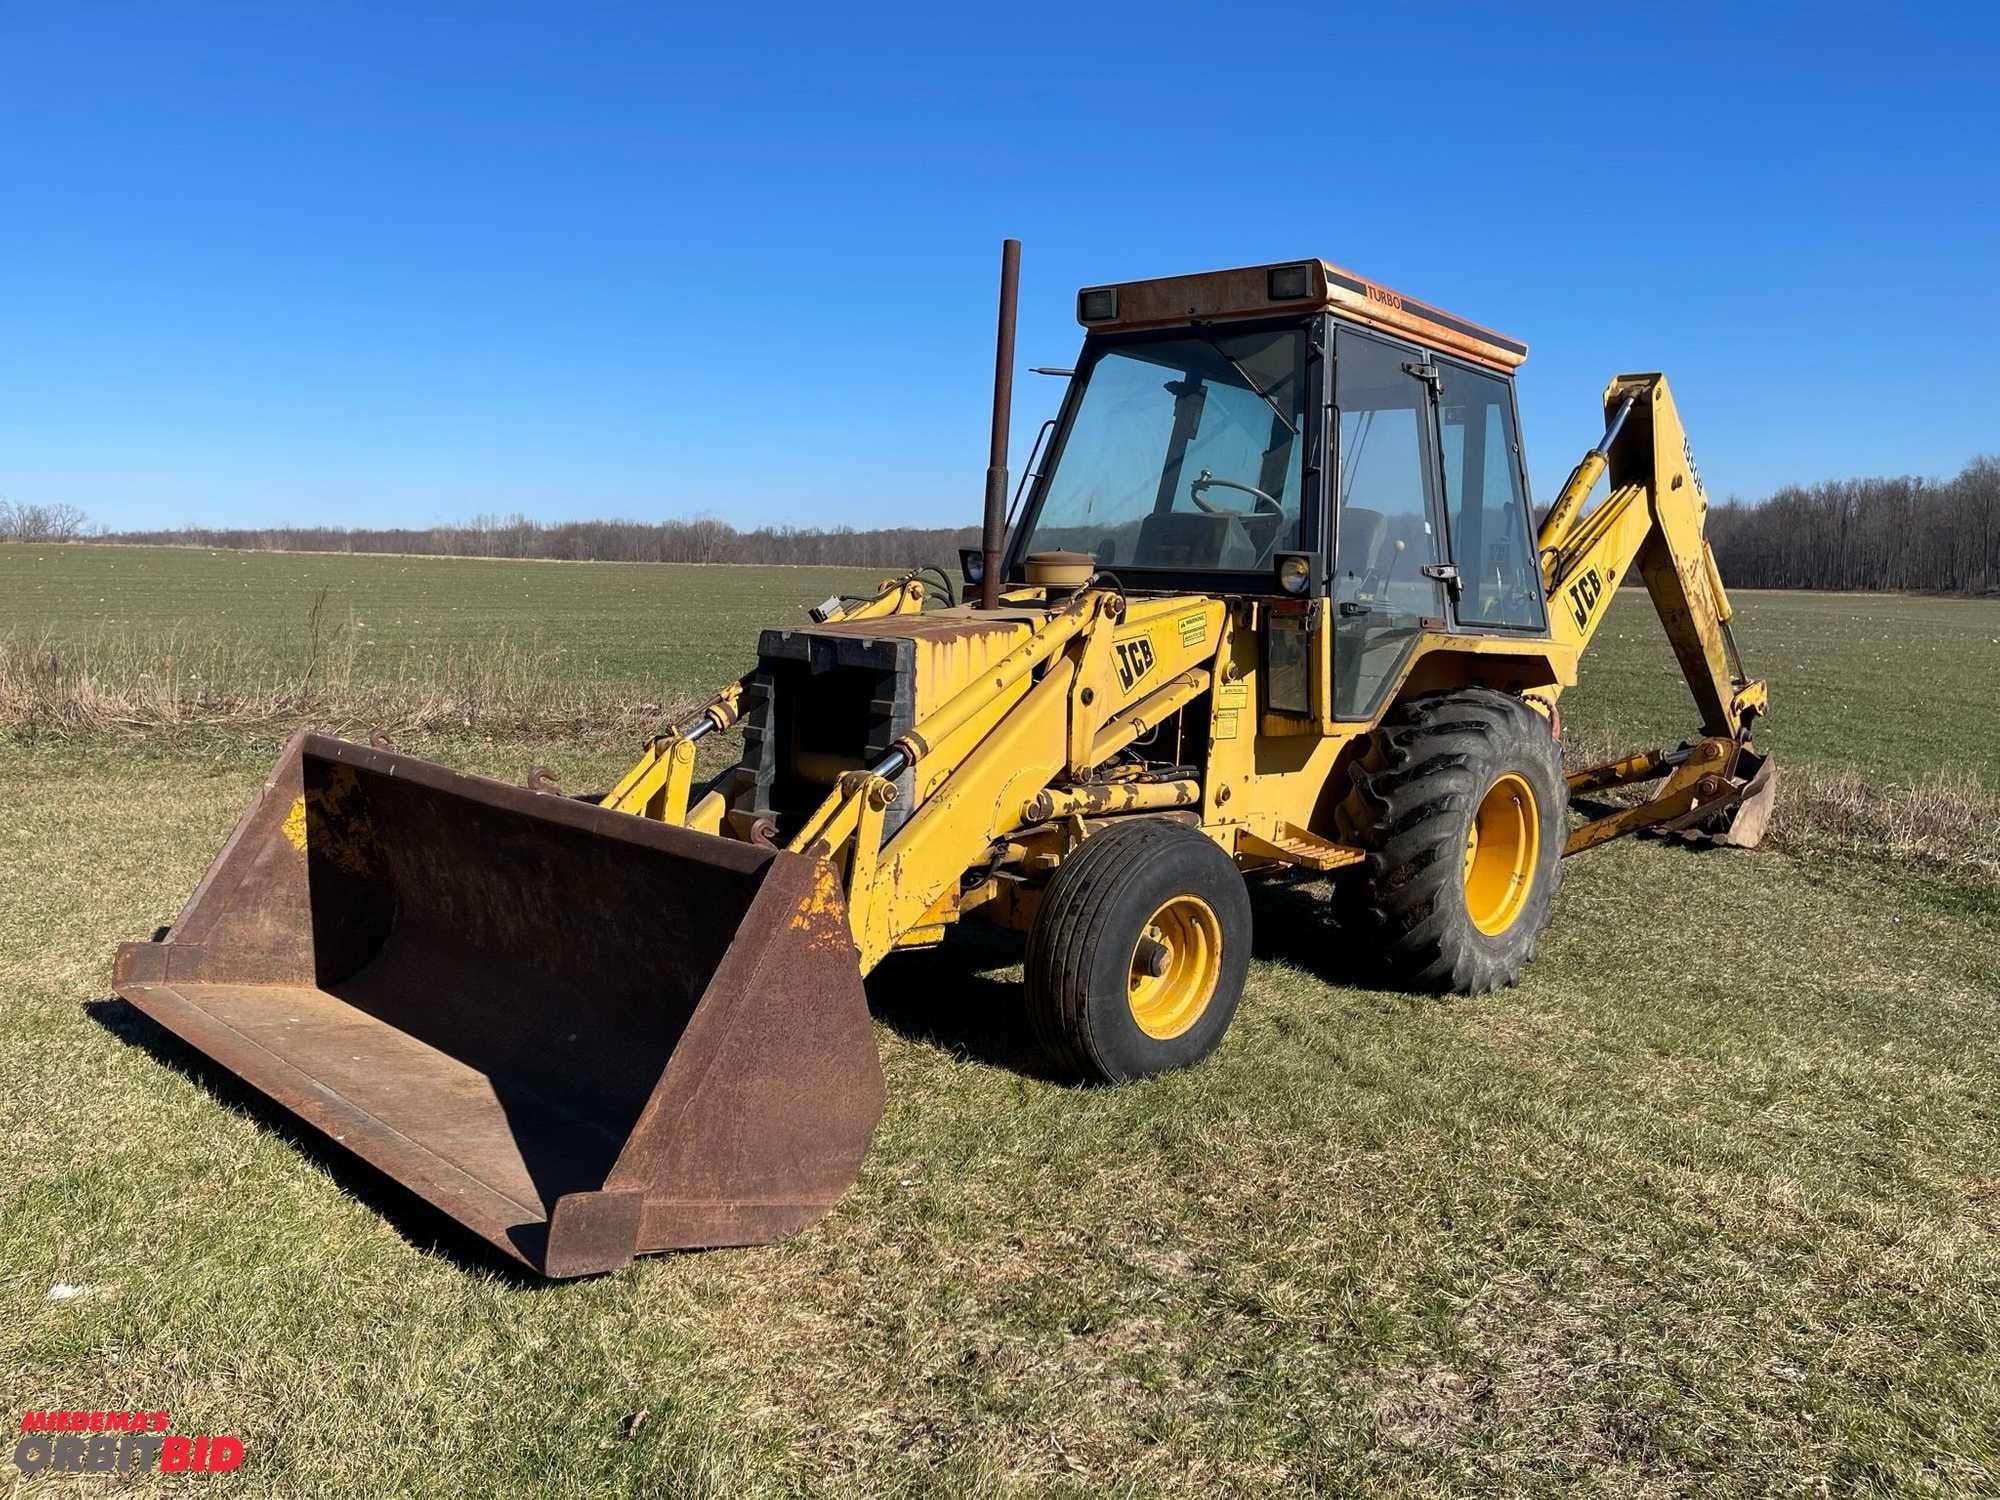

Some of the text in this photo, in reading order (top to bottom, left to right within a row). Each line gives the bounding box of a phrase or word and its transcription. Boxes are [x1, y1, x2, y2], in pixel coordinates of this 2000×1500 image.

[1367, 284, 1402, 311] TURBO
[1569, 567, 1602, 630] JCB
[1116, 638, 1154, 691] JCB
